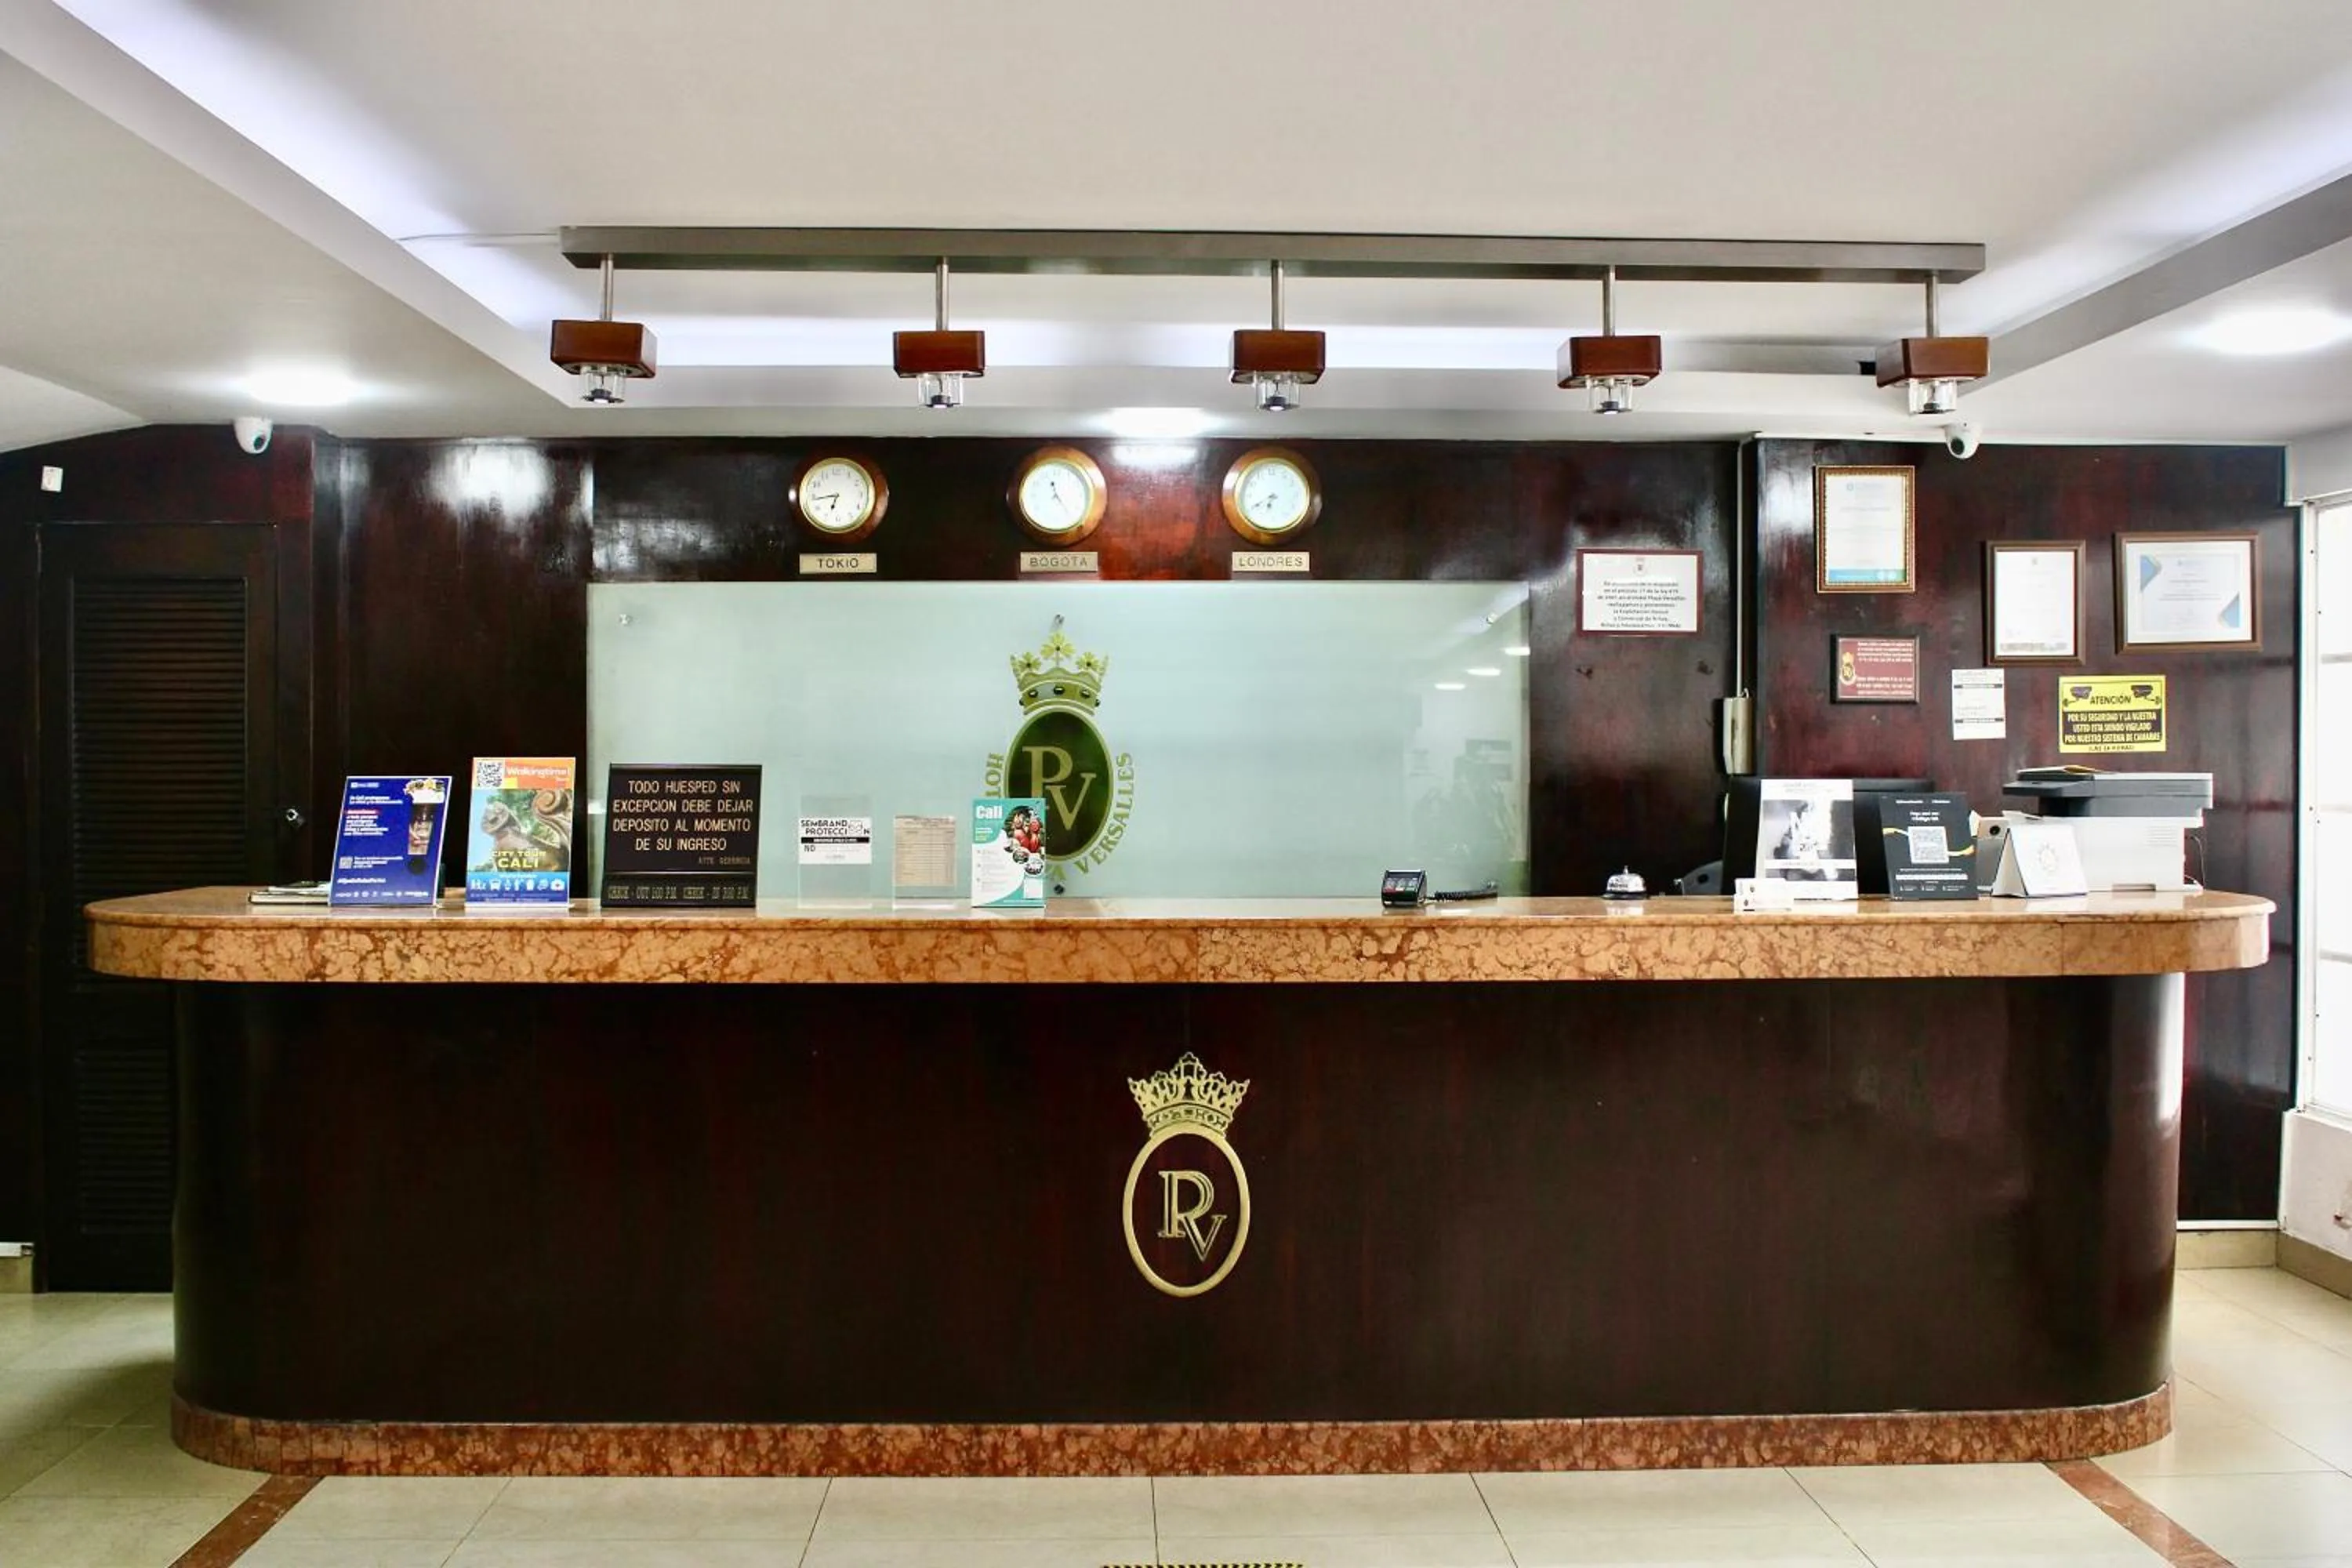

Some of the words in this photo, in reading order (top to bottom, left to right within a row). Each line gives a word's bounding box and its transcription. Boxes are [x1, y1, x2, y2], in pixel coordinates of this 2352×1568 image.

[816, 558, 859, 568] TOKIO
[1029, 557, 1087, 567] BOGOTA
[1239, 557, 1304, 567] LONDRES
[2090, 695, 2132, 705] ATENCIÓN
[628, 780, 659, 793] TODO
[666, 780, 717, 793] HUESPED
[722, 780, 741, 793] SIN
[612, 799, 677, 813] EXCEPCION
[681, 799, 712, 813] DEBE
[717, 799, 753, 812] DEJAR
[1074, 753, 1134, 874] VERSALLES
[612, 818, 669, 832] DEPOSITO
[675, 818, 688, 832] AL
[694, 818, 750, 832] MOMENTO
[635, 837, 651, 851] DE
[656, 837, 672, 851] SU
[677, 837, 727, 851] INGRESO
[498, 858, 539, 869] CALI
